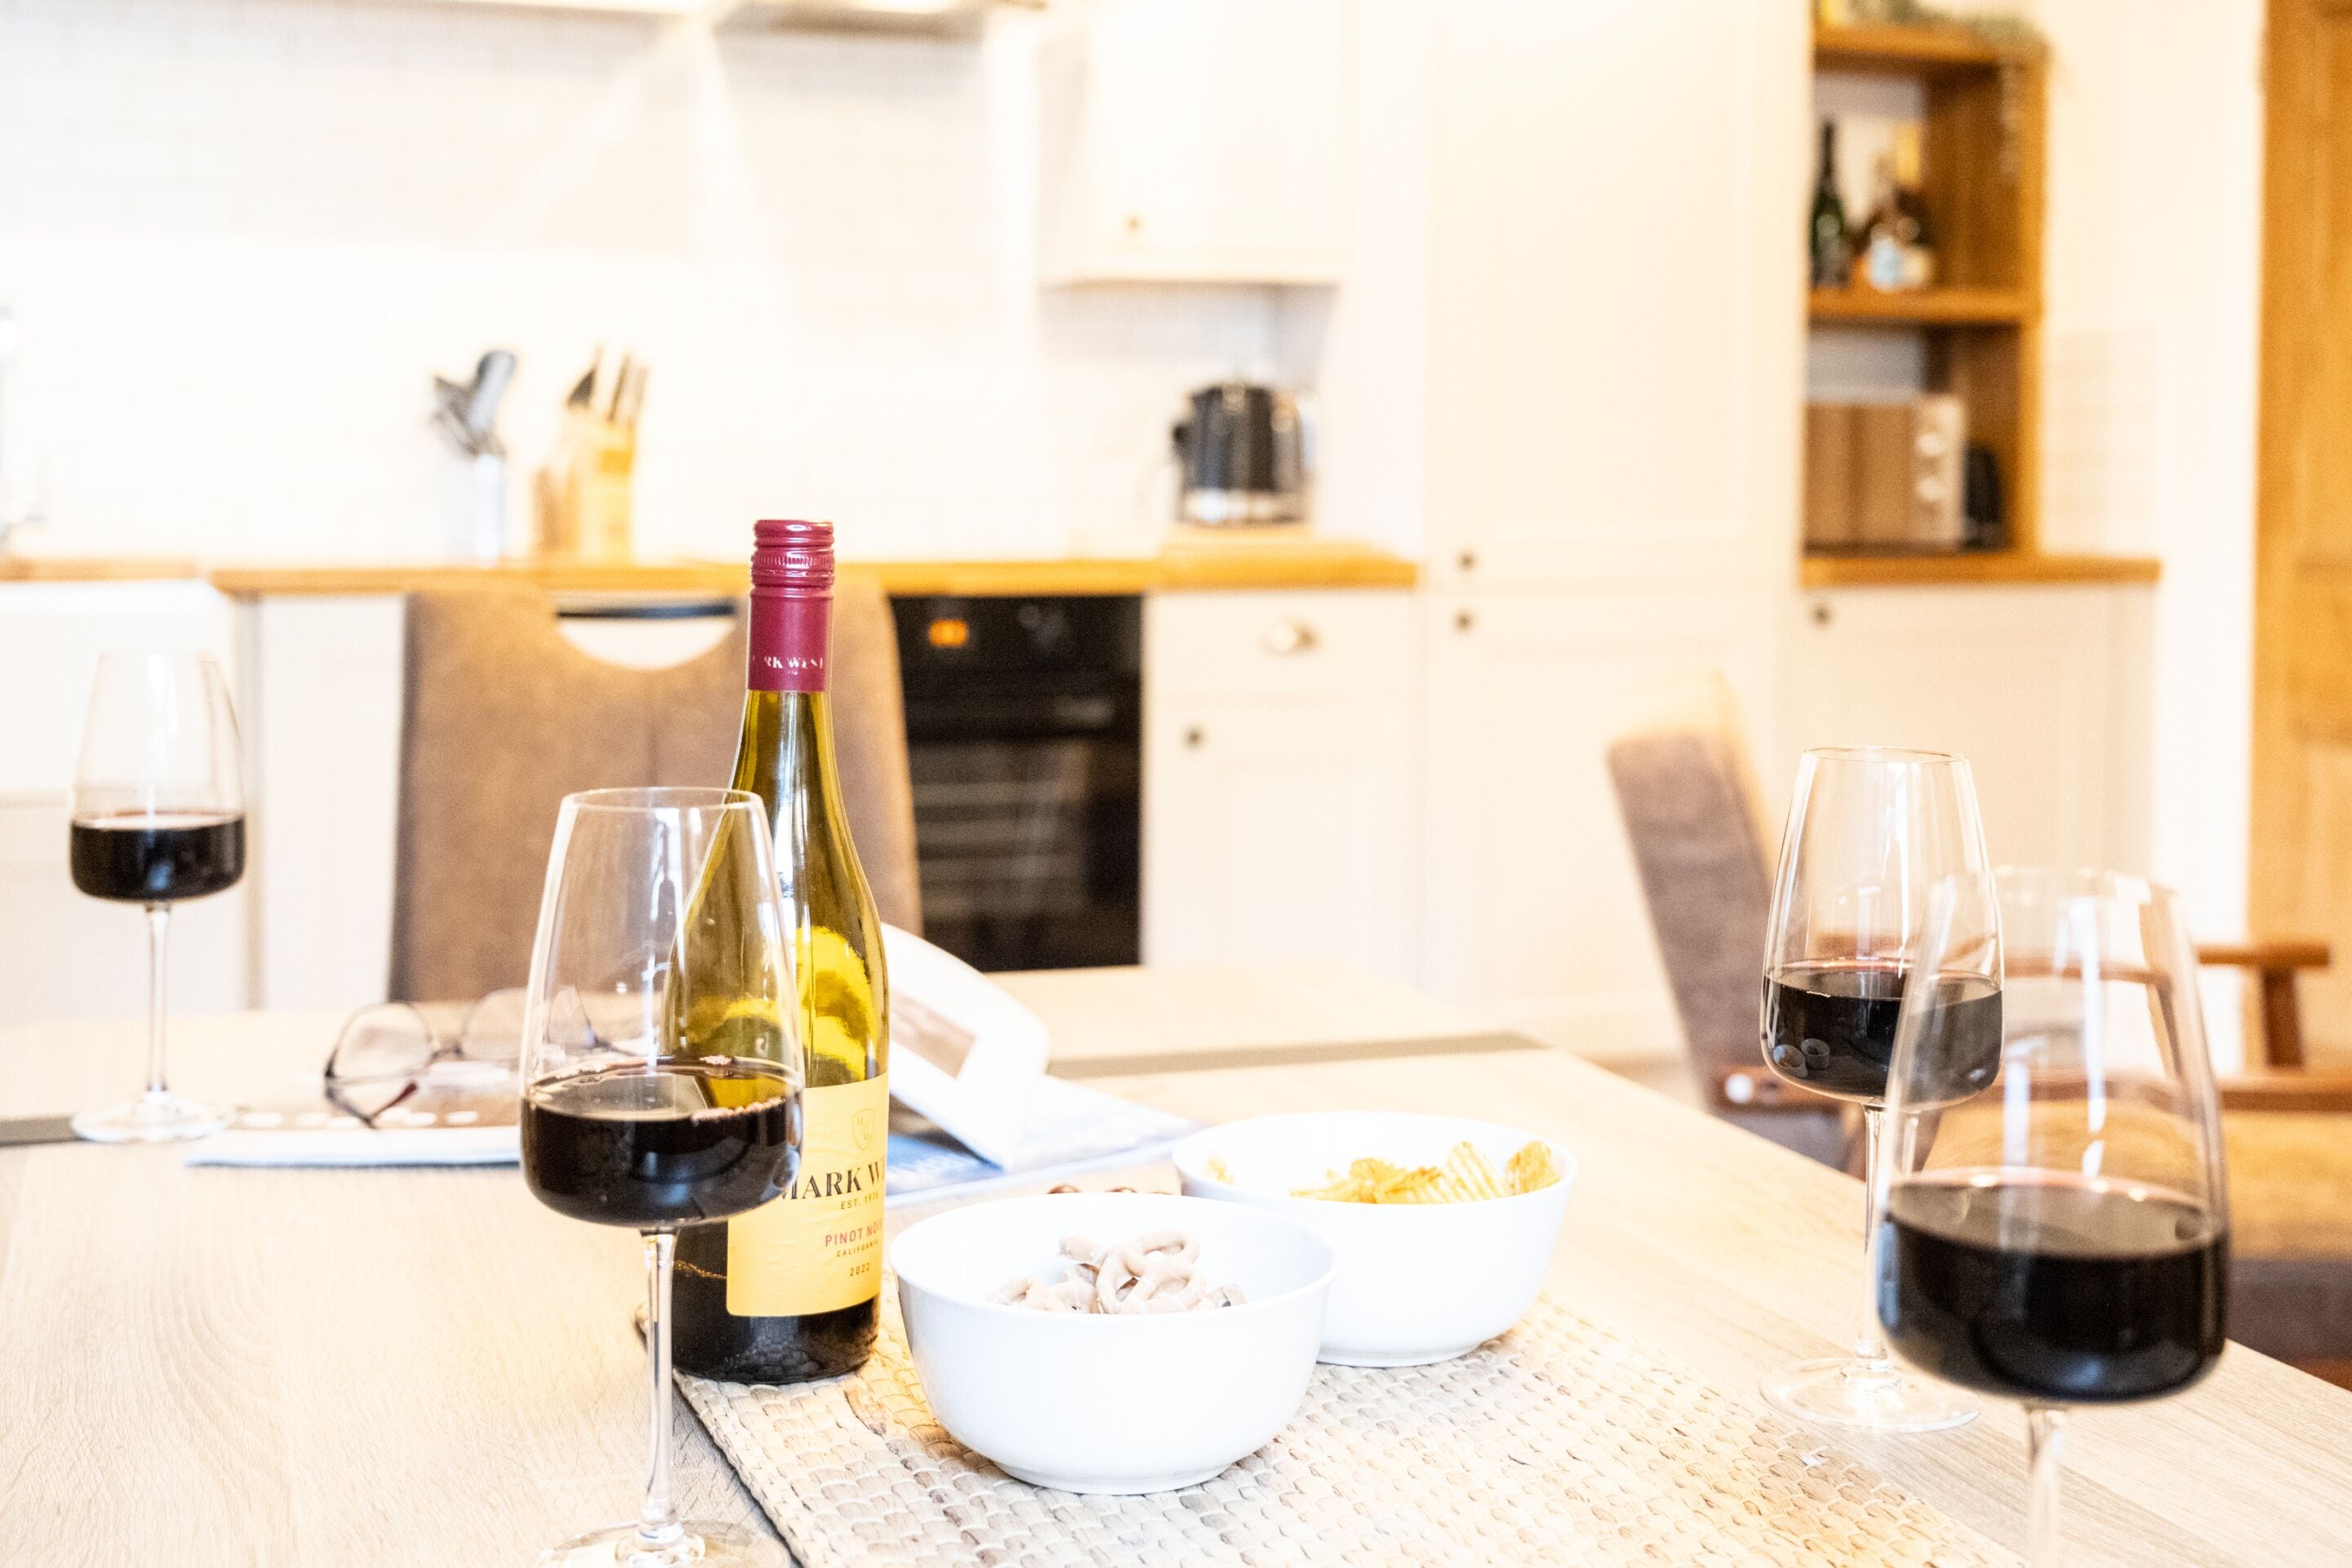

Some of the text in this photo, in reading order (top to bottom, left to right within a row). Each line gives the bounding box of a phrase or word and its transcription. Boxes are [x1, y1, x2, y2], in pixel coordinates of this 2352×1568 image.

[840, 1199, 861, 1210] EST.
[825, 1227, 864, 1247] PINOT
[849, 1262, 871, 1277] 2022
